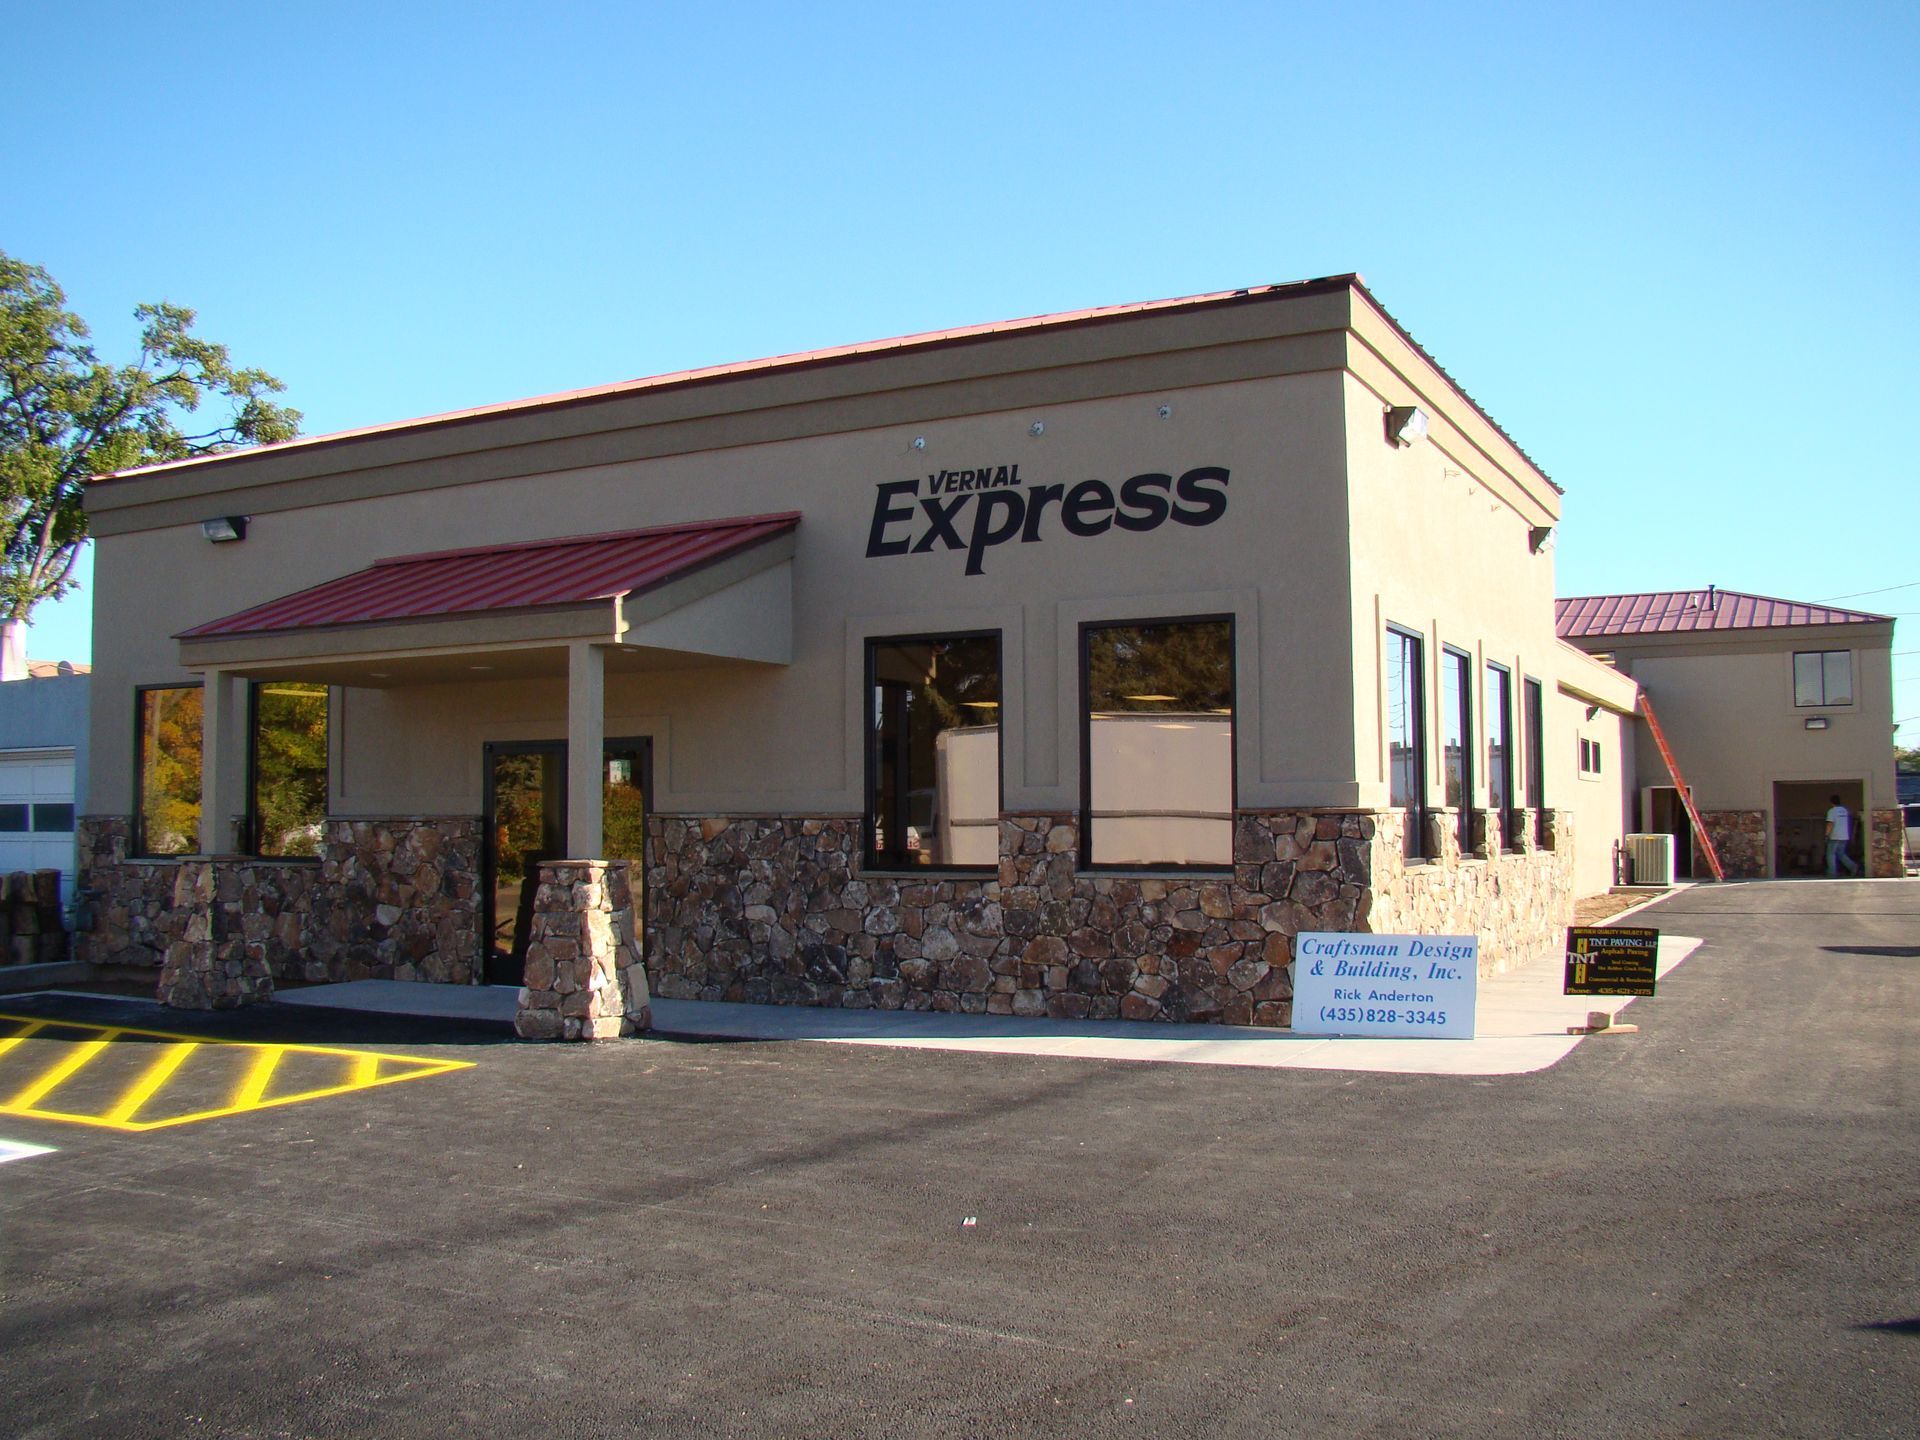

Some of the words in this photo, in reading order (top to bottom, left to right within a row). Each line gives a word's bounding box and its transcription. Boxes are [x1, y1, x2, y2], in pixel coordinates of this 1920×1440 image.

[928, 464, 1022, 495] VERNAL
[865, 466, 1231, 576] Express
[1302, 938, 1399, 958] Craftsman
[1408, 940, 1473, 961] Design
[1589, 938, 1609, 947] TNT
[1610, 938, 1642, 947] PAVING
[1567, 951, 1599, 964] TNT
[1310, 959, 1324, 976] &
[1334, 960, 1418, 981] Building,
[1428, 962, 1462, 980] Inc.
[1334, 988, 1361, 1001] Rick
[1368, 989, 1434, 1003] Anderton
[1320, 1006, 1446, 1025] (435)828-3345
